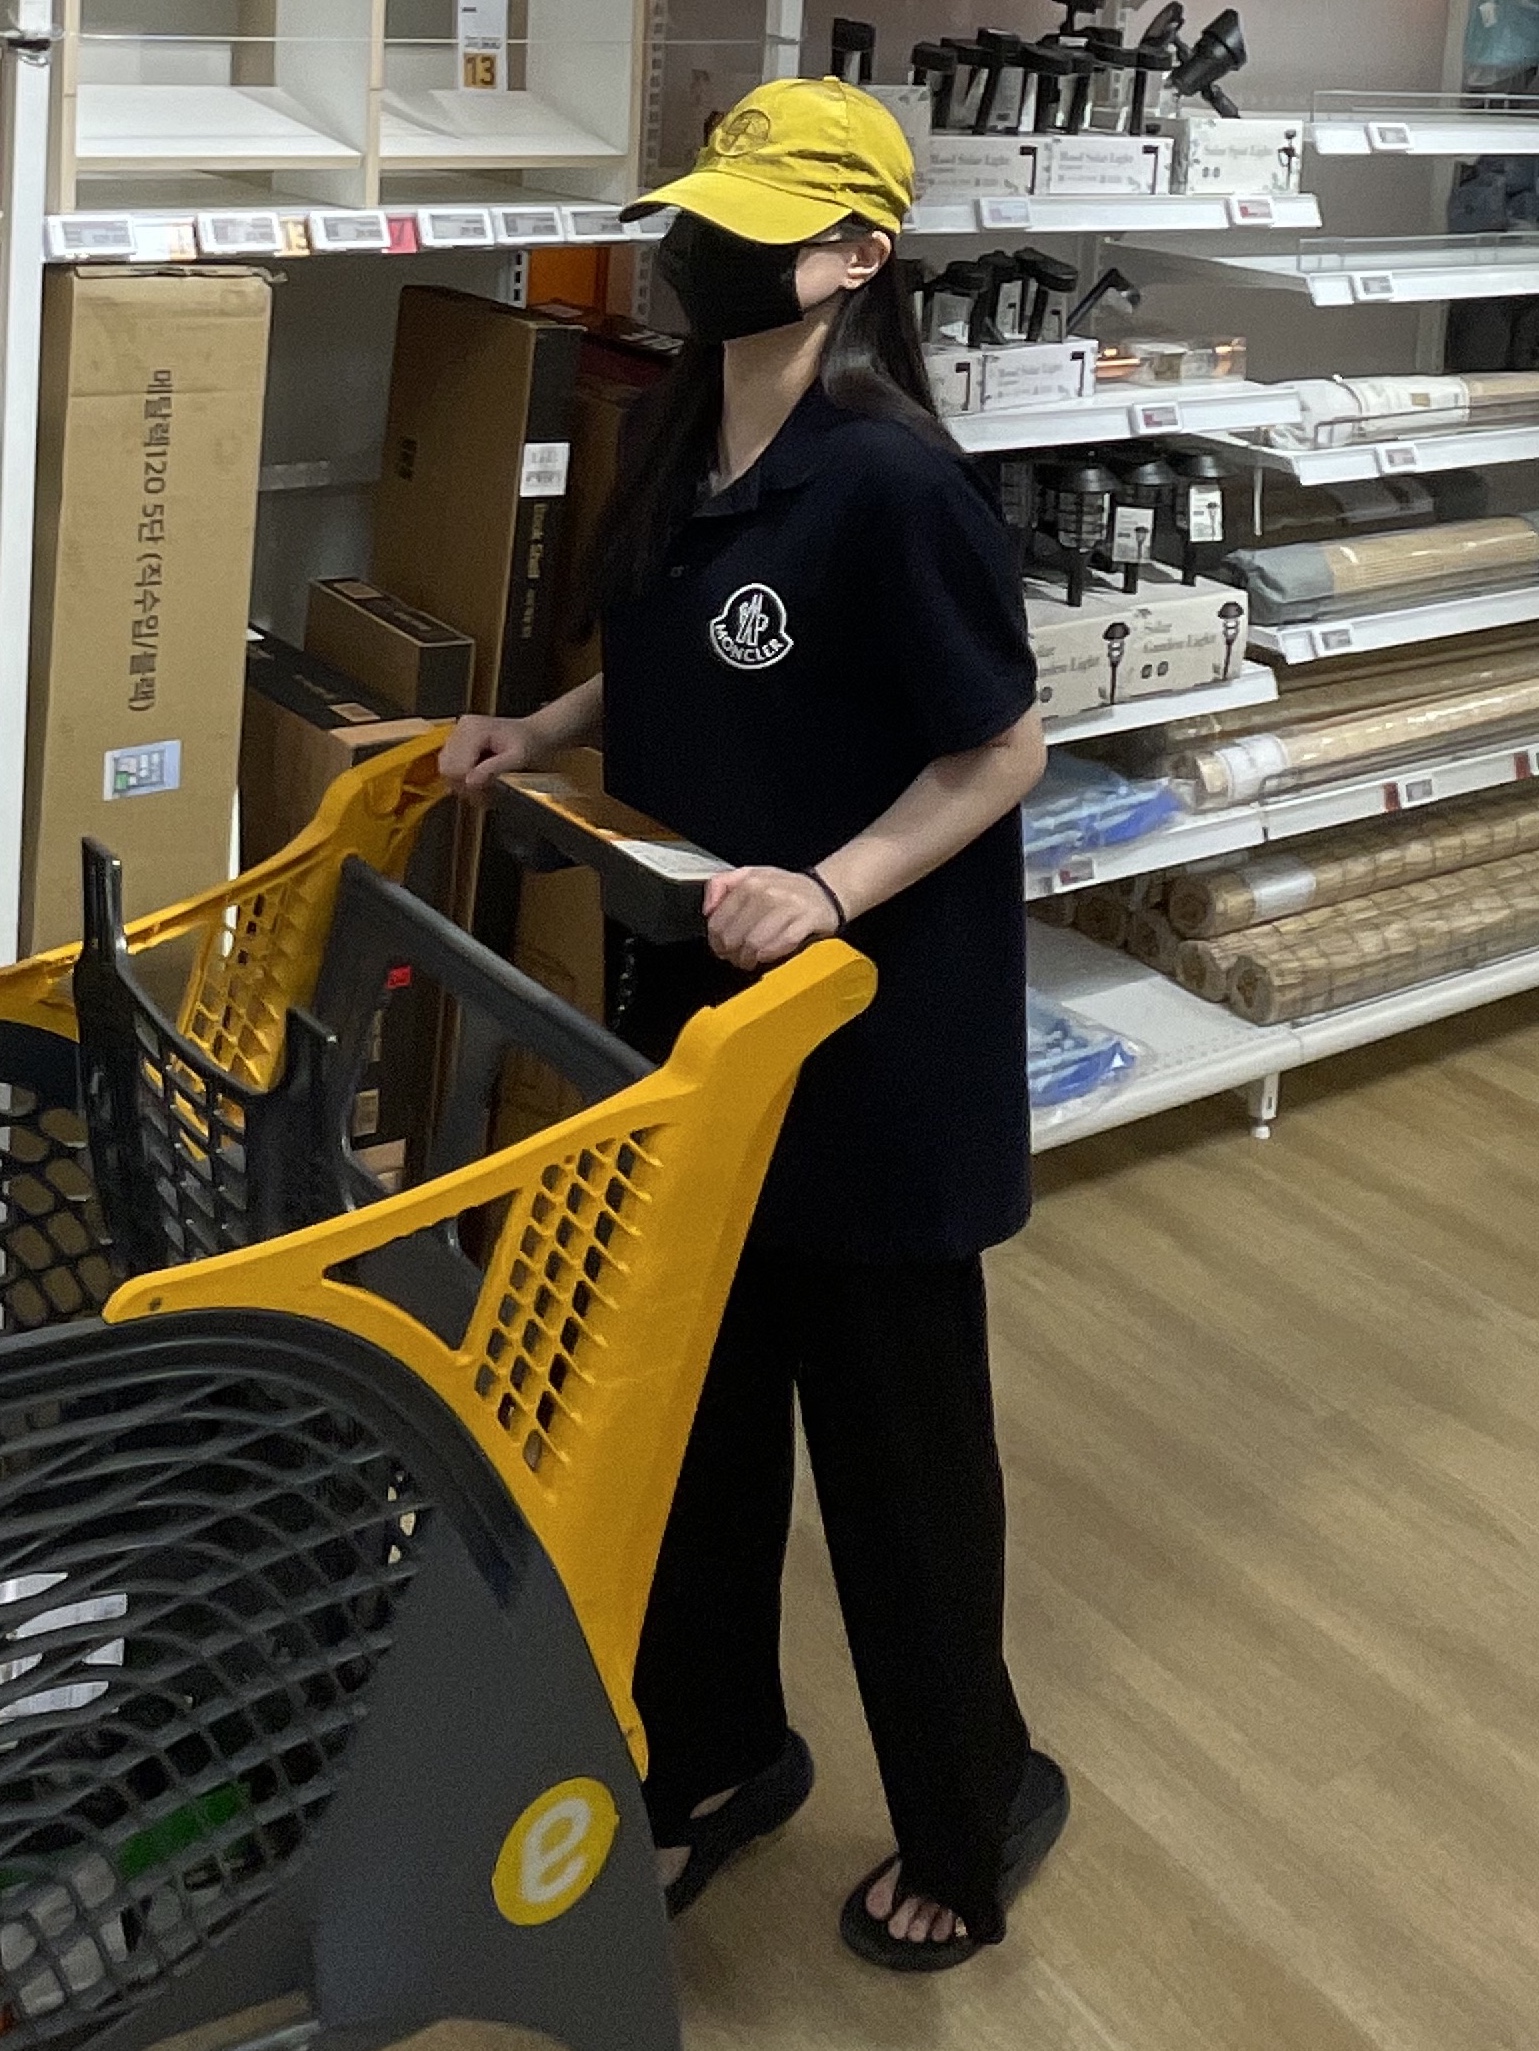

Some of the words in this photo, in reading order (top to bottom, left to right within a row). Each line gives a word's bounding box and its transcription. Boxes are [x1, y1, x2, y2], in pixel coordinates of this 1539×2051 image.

[466, 56, 495, 86] 13
[137, 504, 165, 543] 5단
[714, 623, 784, 662] MONCLER
